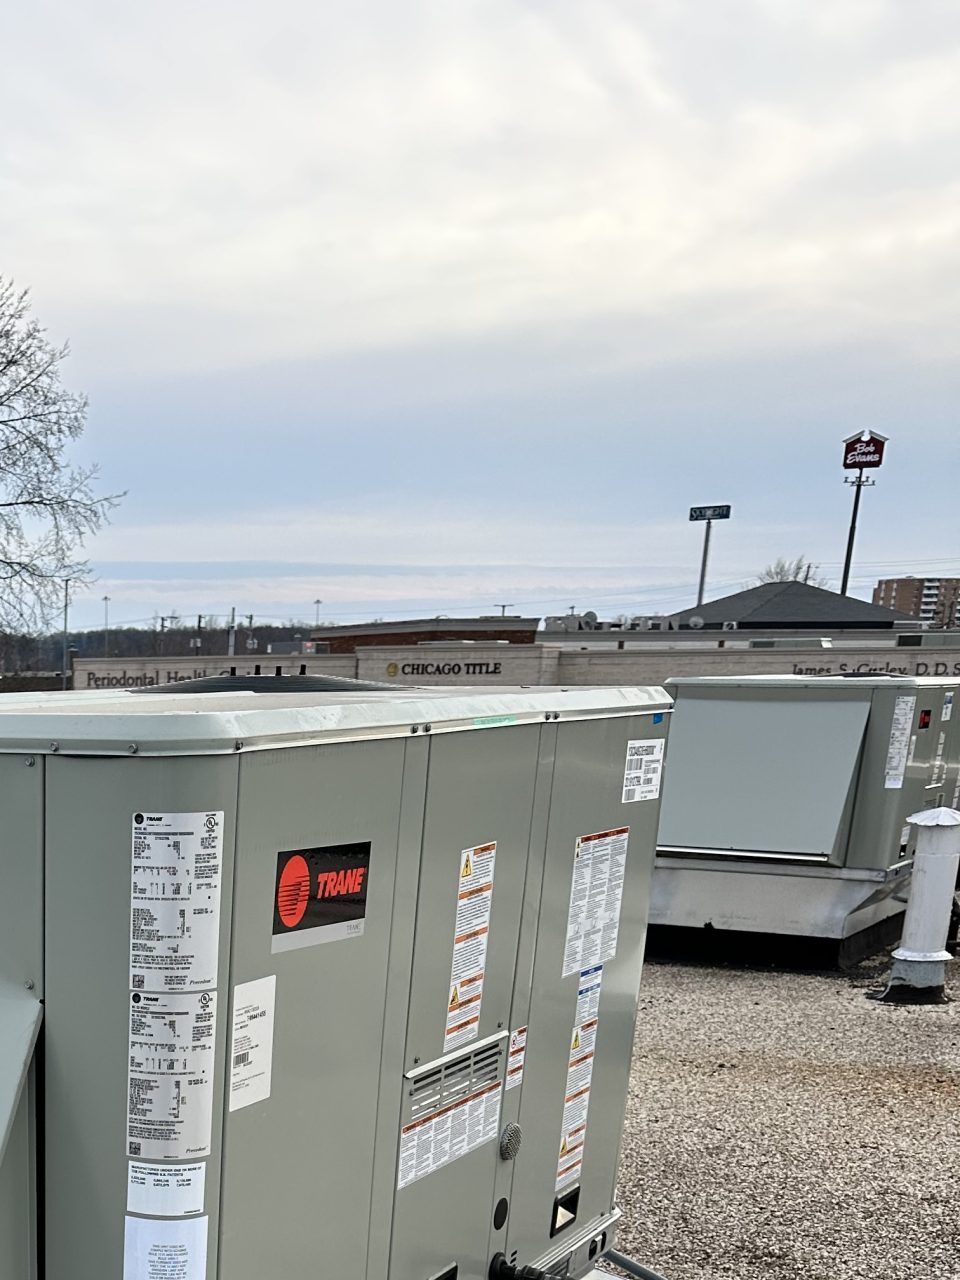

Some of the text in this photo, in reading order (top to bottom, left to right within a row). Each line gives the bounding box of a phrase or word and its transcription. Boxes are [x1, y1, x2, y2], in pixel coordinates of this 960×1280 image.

[854, 443, 875, 453] Bob
[846, 451, 880, 464] Evans
[401, 663, 502, 675] CHICAGO TITLE
[792, 663, 832, 675] James
[87, 670, 159, 687] Periodontal
[317, 867, 365, 899] TRANE
